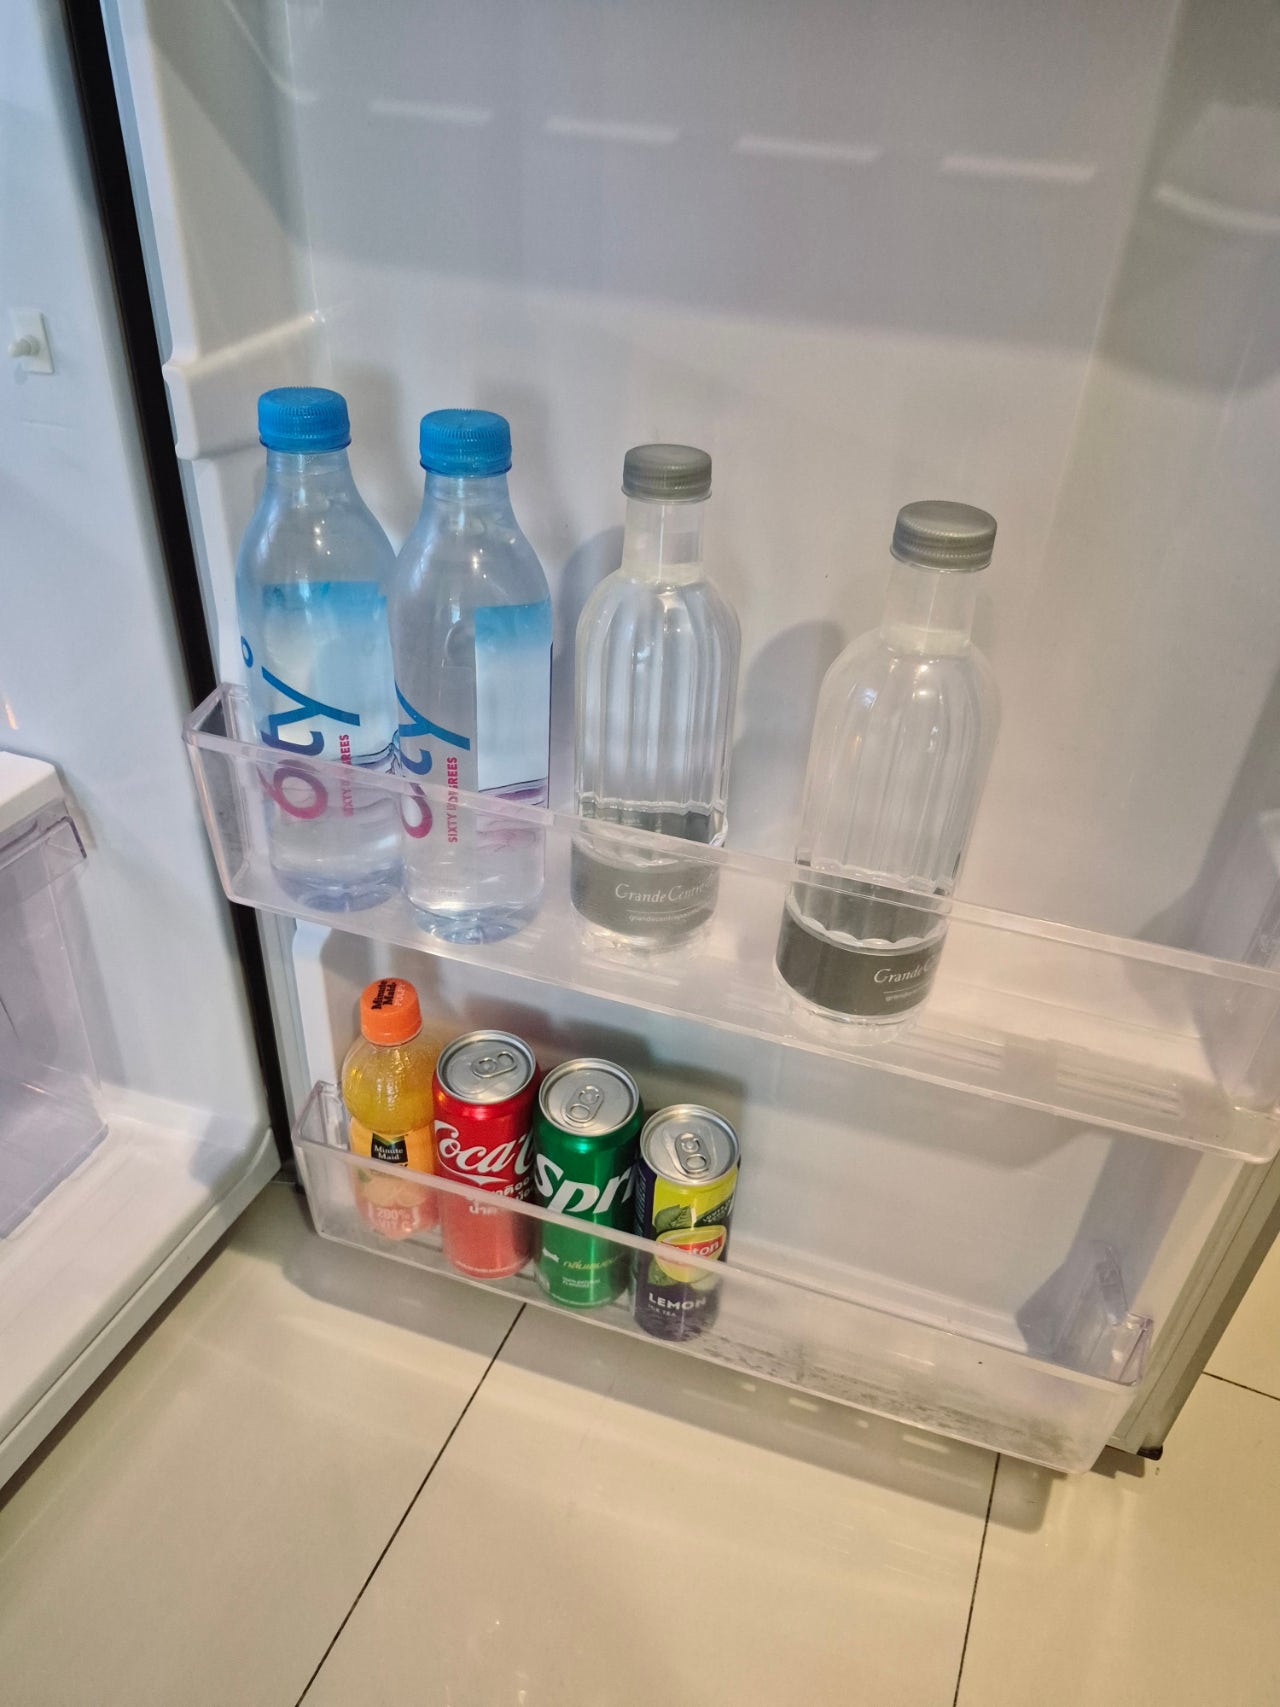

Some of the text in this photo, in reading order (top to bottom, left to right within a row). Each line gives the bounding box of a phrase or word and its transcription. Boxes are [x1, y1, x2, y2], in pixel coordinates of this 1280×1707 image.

[615, 882, 668, 904] Grande
[873, 963, 923, 984] Grande
[374, 1144, 404, 1154] Minute
[378, 1152, 400, 1161] Maid
[648, 1291, 707, 1311] LEMON
